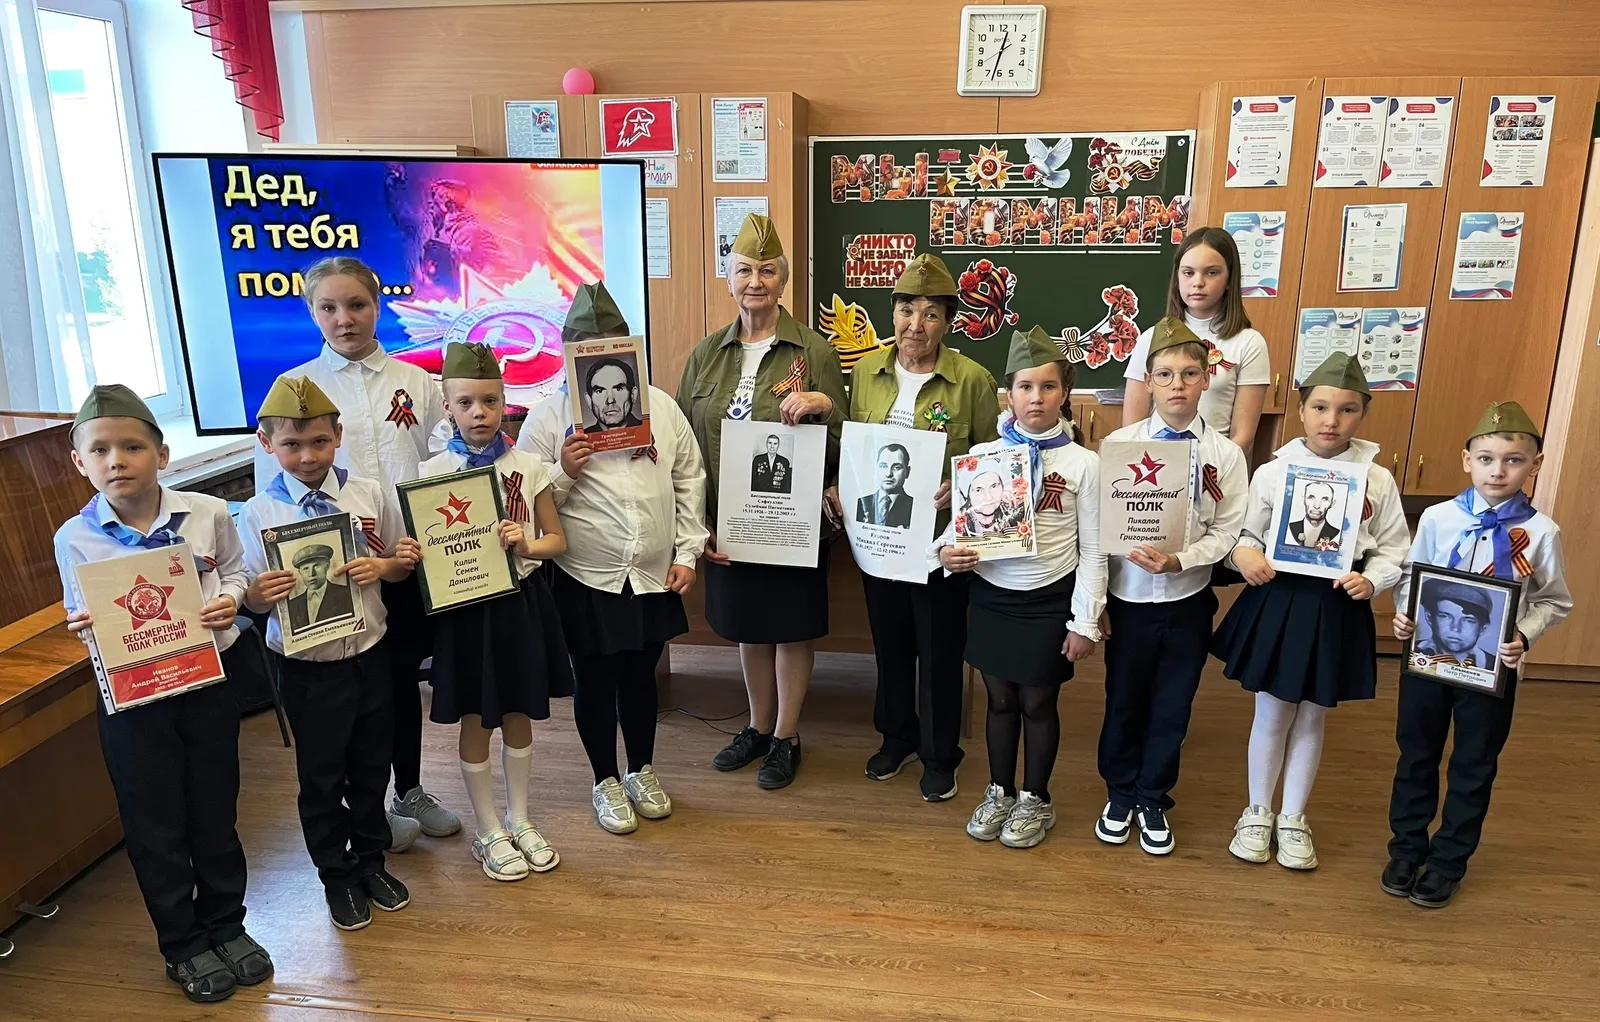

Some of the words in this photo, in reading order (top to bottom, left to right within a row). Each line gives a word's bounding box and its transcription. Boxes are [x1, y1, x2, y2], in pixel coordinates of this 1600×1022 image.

[1021, 34, 1026, 42] 2
[978, 47, 984, 55] 9
[224, 165, 318, 206] Дед,
[831, 152, 929, 203] МЫ
[929, 195, 1191, 246] ПОМНИМ
[230, 224, 256, 248] я
[264, 214, 359, 248] тебя
[860, 236, 914, 249] НИКТО
[861, 250, 874, 259] НЕ
[876, 250, 914, 260] ЗАБЫТ,
[846, 260, 906, 277] НИЧТО
[846, 277, 862, 287] НЕ
[863, 277, 896, 287] ЗАБЫ
[1112, 478, 1184, 501] бессмертный
[1126, 502, 1163, 511] ПОЛК
[425, 520, 496, 546] бессмертный
[1120, 534, 1166, 542] Григорьевич
[444, 539, 482, 556] ПОЛК
[454, 558, 477, 567] Килин
[456, 566, 479, 576] Семен
[449, 572, 489, 588] Данилович
[122, 619, 186, 645] БЕССМЕРТНЫЙ
[127, 638, 151, 653] ПОЛК
[154, 630, 187, 646] РОССИИ
[131, 677, 159, 688] Андрей
[161, 665, 202, 680] Васильевич
[152, 665, 178, 676] Иванов
